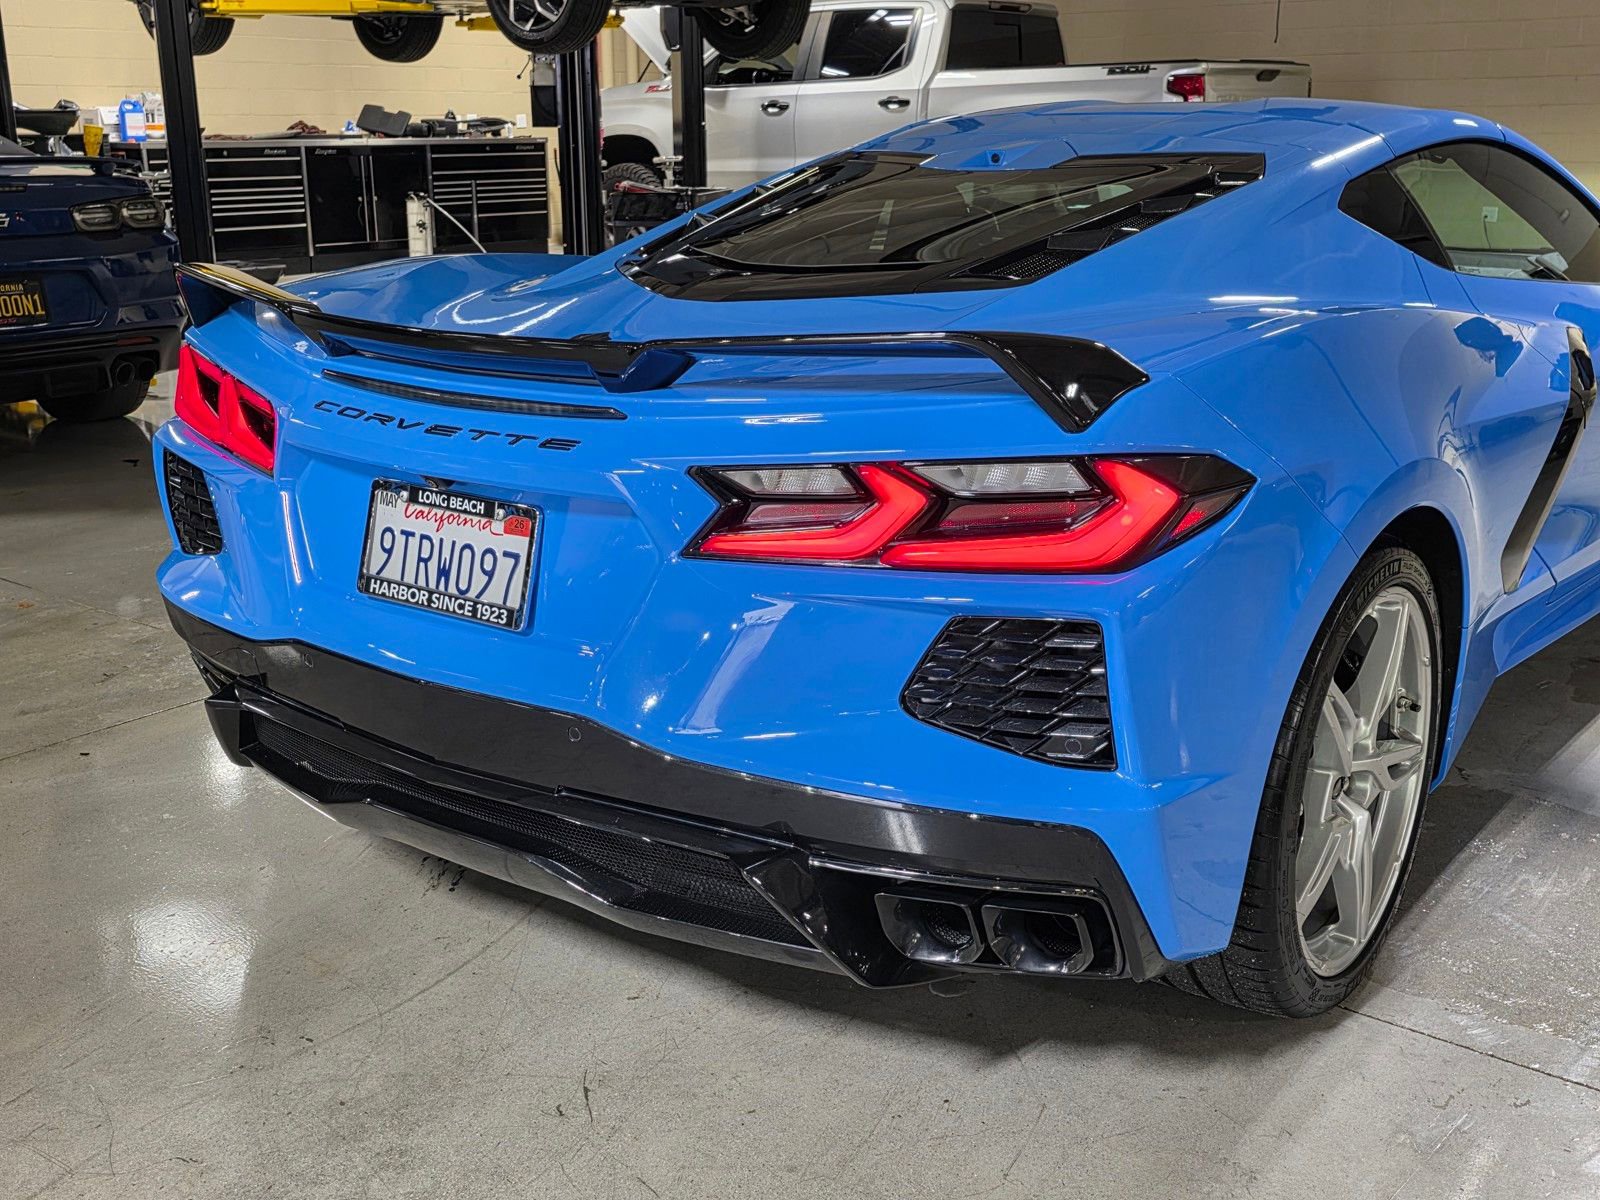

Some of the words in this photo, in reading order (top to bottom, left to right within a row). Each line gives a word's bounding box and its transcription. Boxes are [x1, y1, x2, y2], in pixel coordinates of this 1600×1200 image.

[0, 293, 45, 318] OON1
[314, 400, 581, 451] CORVETTE
[379, 491, 400, 508] MAY
[418, 490, 448, 507] LONG
[450, 495, 485, 514] BEACH
[404, 503, 503, 536] California
[514, 518, 525, 529] 26
[376, 526, 521, 605] 9TRW097
[1357, 560, 1401, 608] MICHELIN
[370, 579, 429, 606] HARBOR
[431, 593, 473, 615] SINCE
[476, 604, 508, 624] 1923
